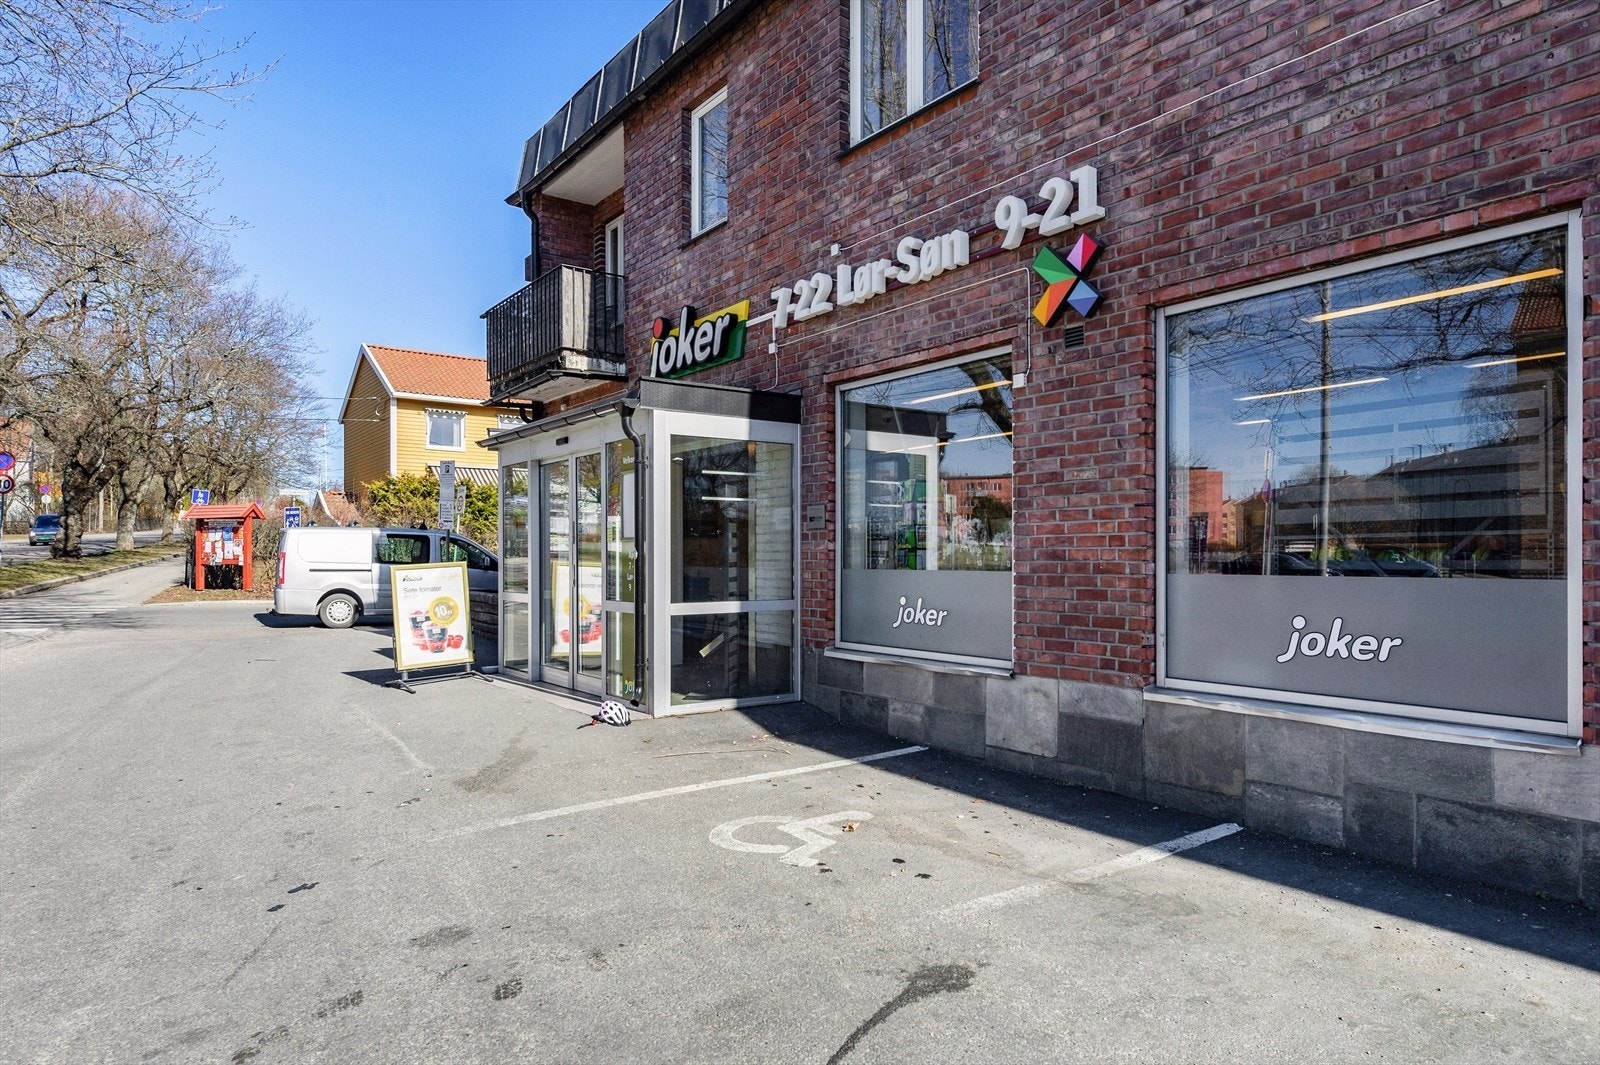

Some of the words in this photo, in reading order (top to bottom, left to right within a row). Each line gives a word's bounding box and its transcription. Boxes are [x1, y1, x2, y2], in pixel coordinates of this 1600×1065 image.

[771, 274, 833, 328] 7-22
[837, 229, 969, 306] Lør-Søn
[994, 165, 1105, 249] 9-21
[650, 305, 735, 378] joker
[892, 596, 948, 628] joker
[1276, 615, 1403, 663] joker
